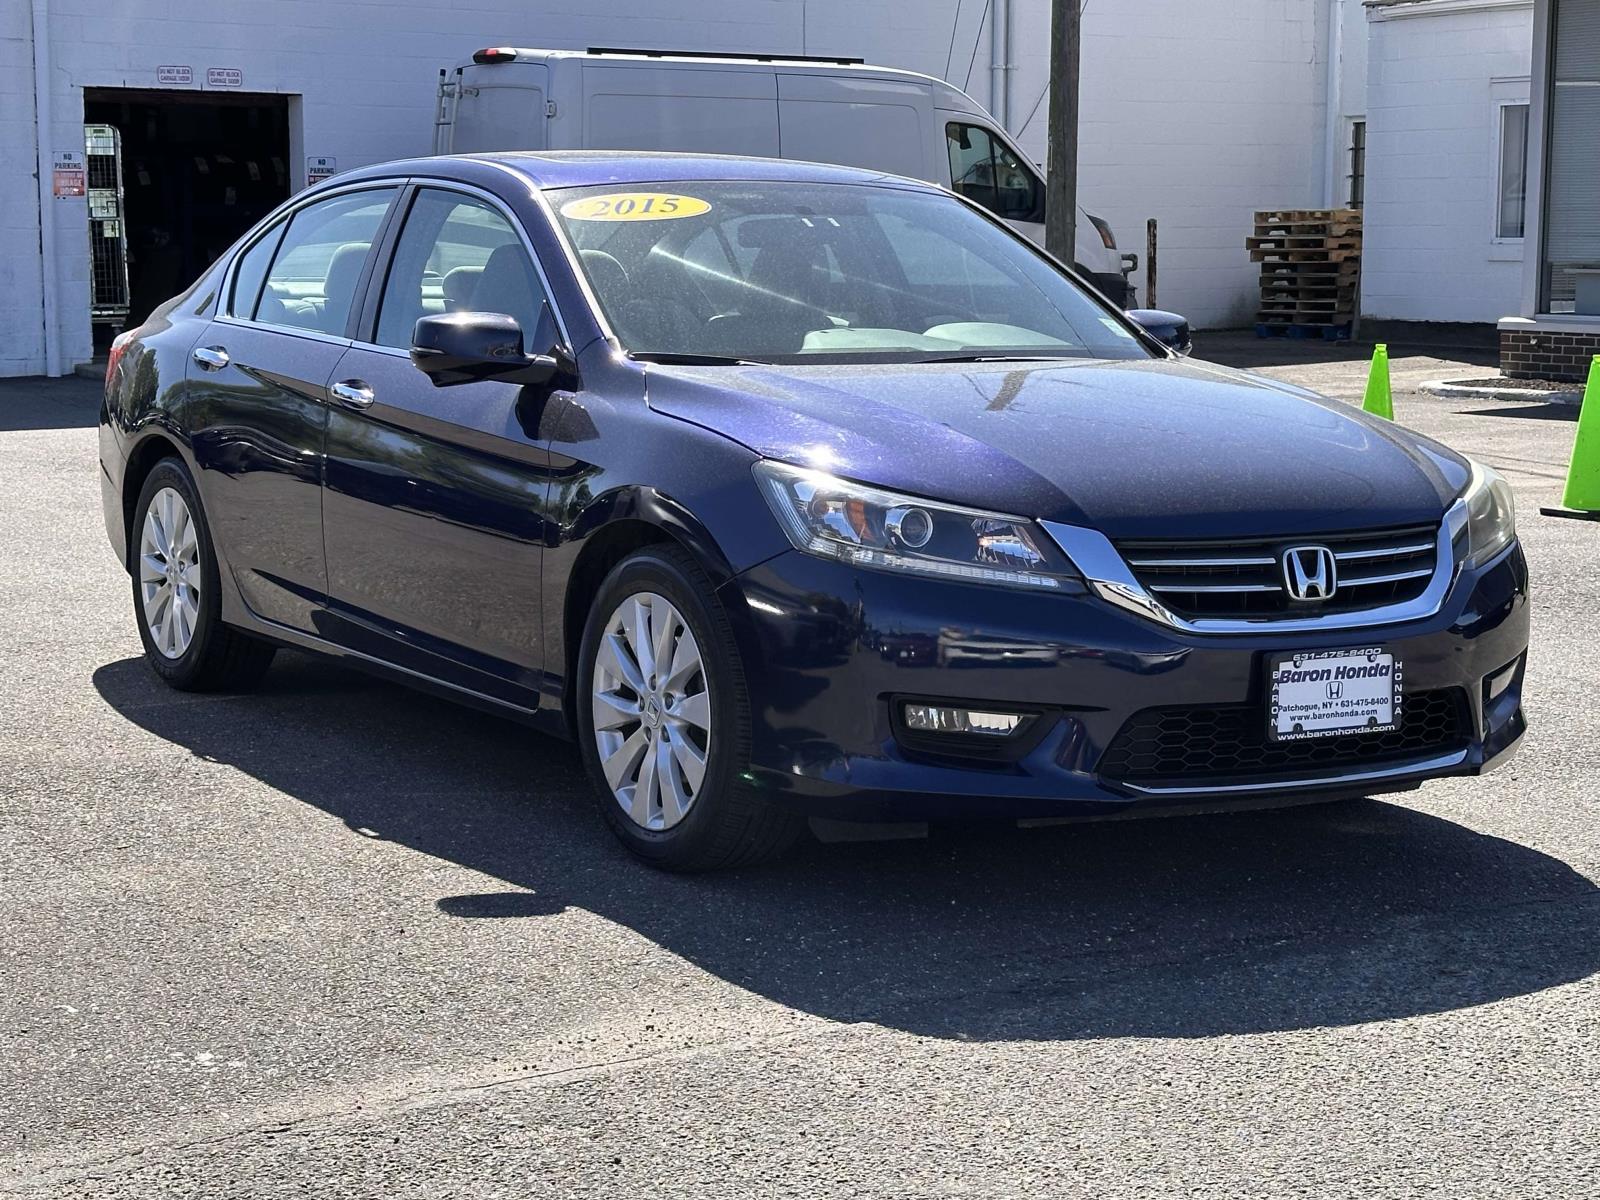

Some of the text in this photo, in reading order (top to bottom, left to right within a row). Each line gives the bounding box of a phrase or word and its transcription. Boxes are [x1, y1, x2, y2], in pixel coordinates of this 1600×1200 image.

[590, 198, 681, 217] 2015
[1293, 647, 1382, 662] 631-475-8400
[1279, 663, 1390, 684] Baron Honda
[1394, 661, 1403, 714] HONDA
[1271, 671, 1280, 727] BARON
[1278, 696, 1389, 713] Patchogue, NY 631-475-8400
[1289, 708, 1378, 722] www.baronhonda.com
[1277, 723, 1396, 741] www.baronhonda.com
